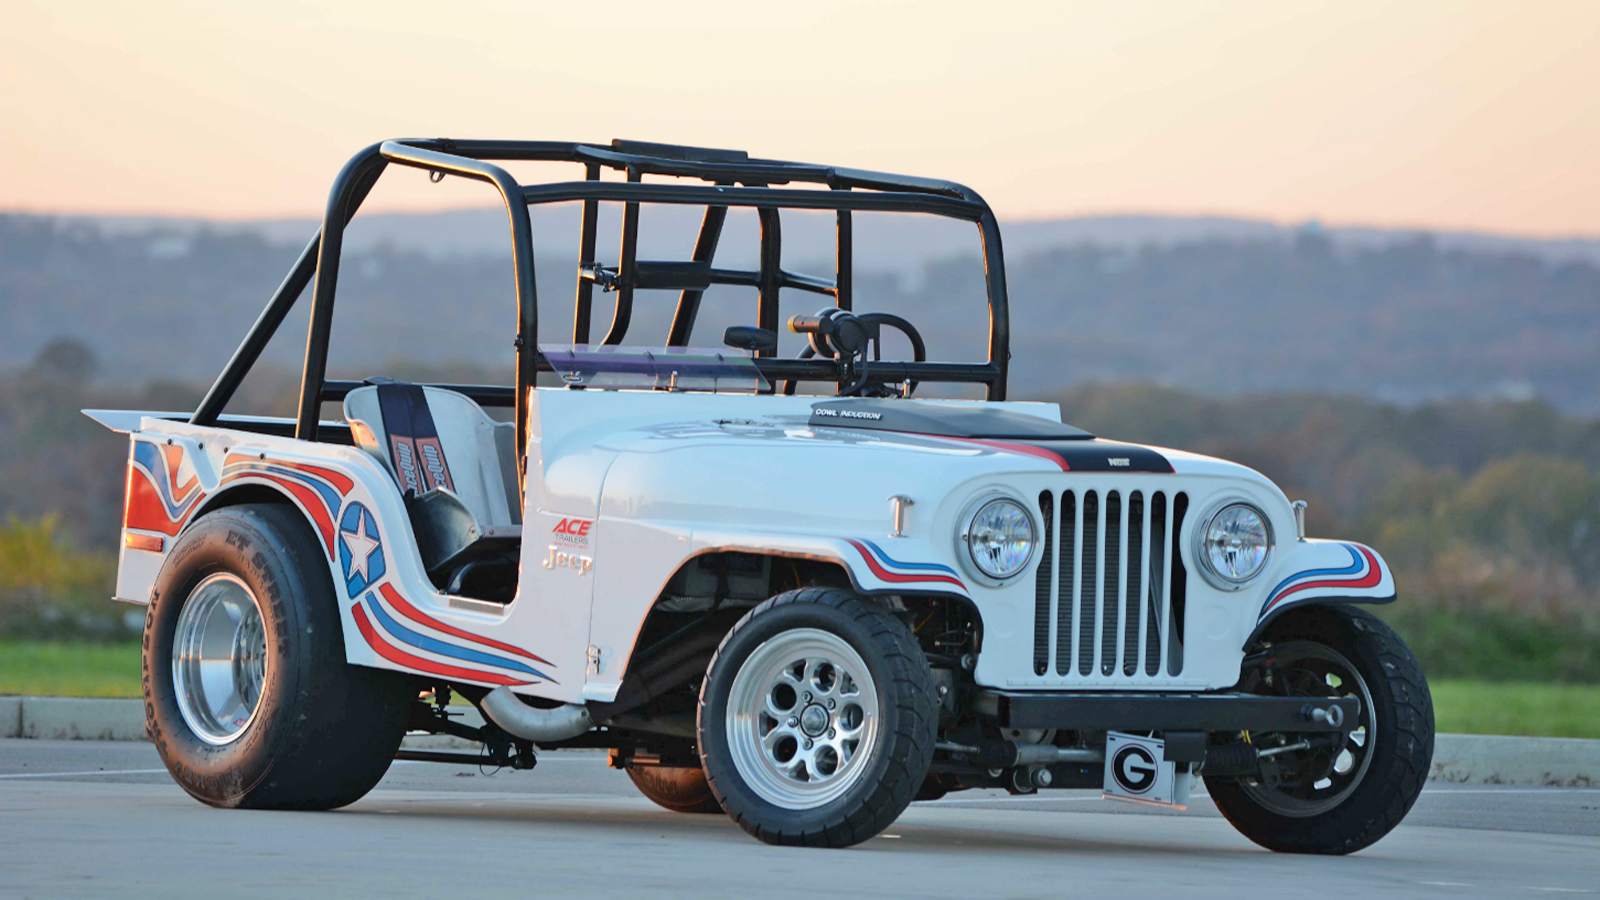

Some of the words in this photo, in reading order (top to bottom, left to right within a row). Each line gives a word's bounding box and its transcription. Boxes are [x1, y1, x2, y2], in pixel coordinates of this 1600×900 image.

[815, 408, 838, 417] COWL
[840, 410, 882, 420] INDUCTION
[552, 517, 593, 537] ACE
[555, 533, 589, 546] TRAILERS
[542, 544, 593, 576] Jeep
[225, 530, 251, 552] ET
[251, 551, 290, 658] STREET
[142, 588, 169, 761] THOMPSON
[173, 760, 245, 794] MICKEY
[1113, 746, 1156, 791] G
